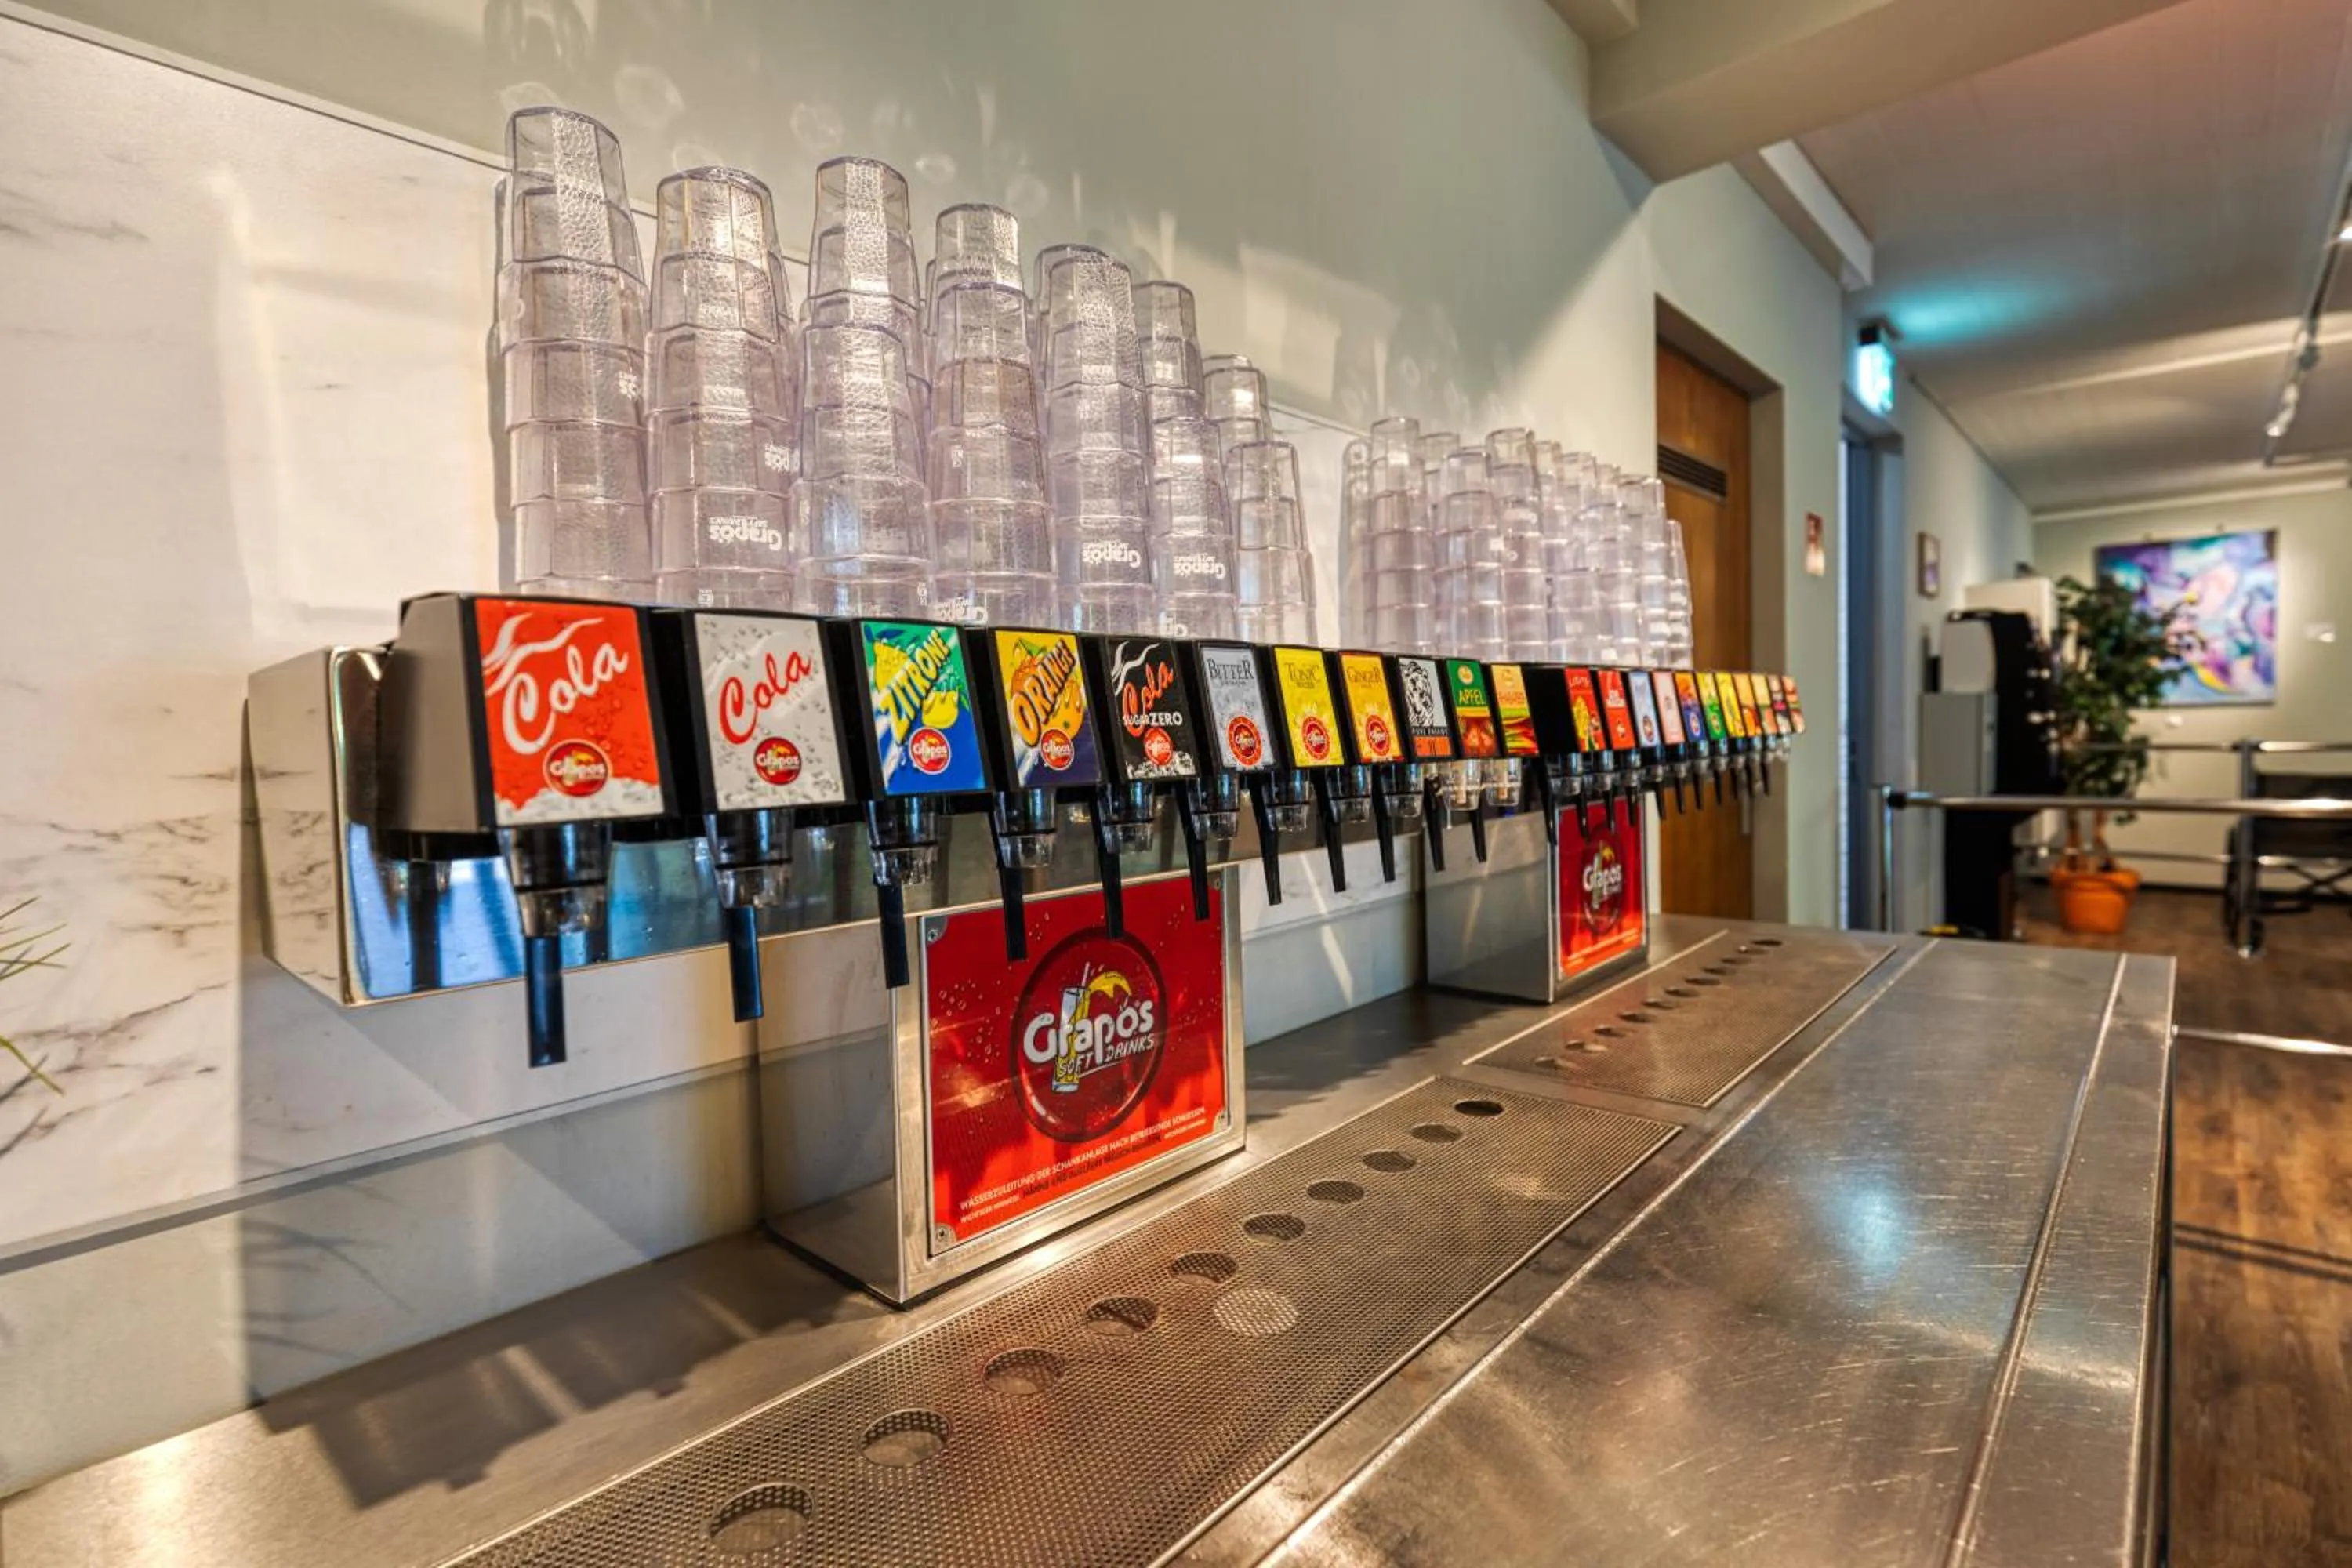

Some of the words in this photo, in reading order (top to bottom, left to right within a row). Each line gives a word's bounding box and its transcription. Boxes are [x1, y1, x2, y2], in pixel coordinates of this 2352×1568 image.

[502, 641, 629, 755] Cola
[720, 650, 812, 746] Cola
[880, 629, 951, 745] ZITRONE
[1012, 639, 1076, 747] ORANGE
[1122, 662, 1174, 738] Cola
[1207, 658, 1254, 680] BITTER
[1284, 662, 1321, 683] TONIC
[1346, 665, 1382, 684] GINGER
[1458, 689, 1485, 705] APFEL
[1023, 999, 1155, 1065] Grapos
[1059, 1051, 1094, 1077] SOFT
[1105, 1033, 1155, 1062] DRINKS
